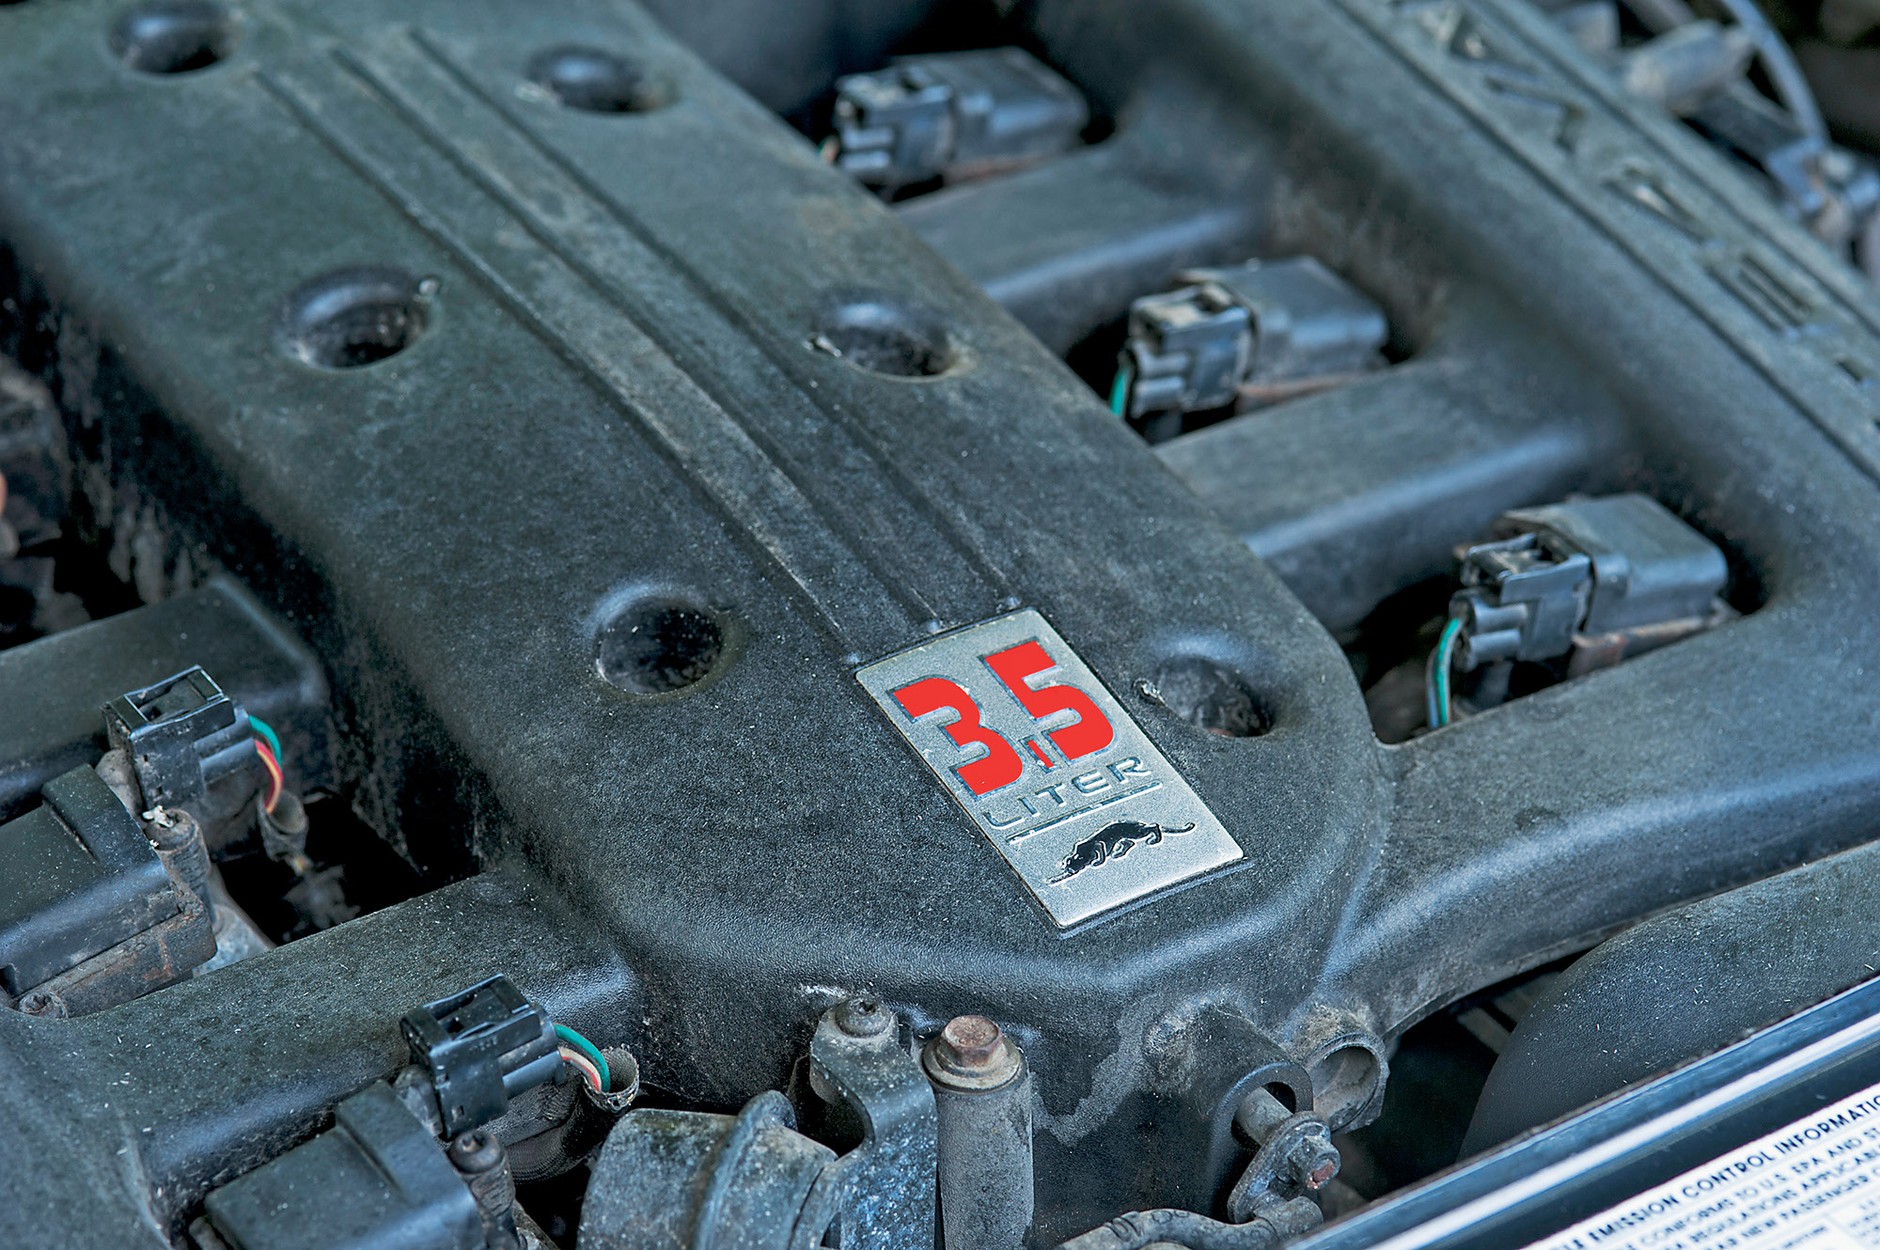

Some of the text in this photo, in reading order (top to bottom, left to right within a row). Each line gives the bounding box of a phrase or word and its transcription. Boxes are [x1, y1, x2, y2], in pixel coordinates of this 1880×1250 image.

[888, 637, 1115, 799] 3.5
[983, 755, 1151, 830] LITER
[1588, 1195, 1680, 1242] EMISSION
[1682, 1151, 1776, 1199] CONTROL
[1641, 1198, 1735, 1246] CONFORMS
[1734, 1186, 1759, 1201] TO
[1791, 1156, 1824, 1175] EPA
[1827, 1137, 1863, 1158] AND
[1690, 1188, 1798, 1243] REGULATIONS
[1779, 1174, 1869, 1221] PASSENGER
